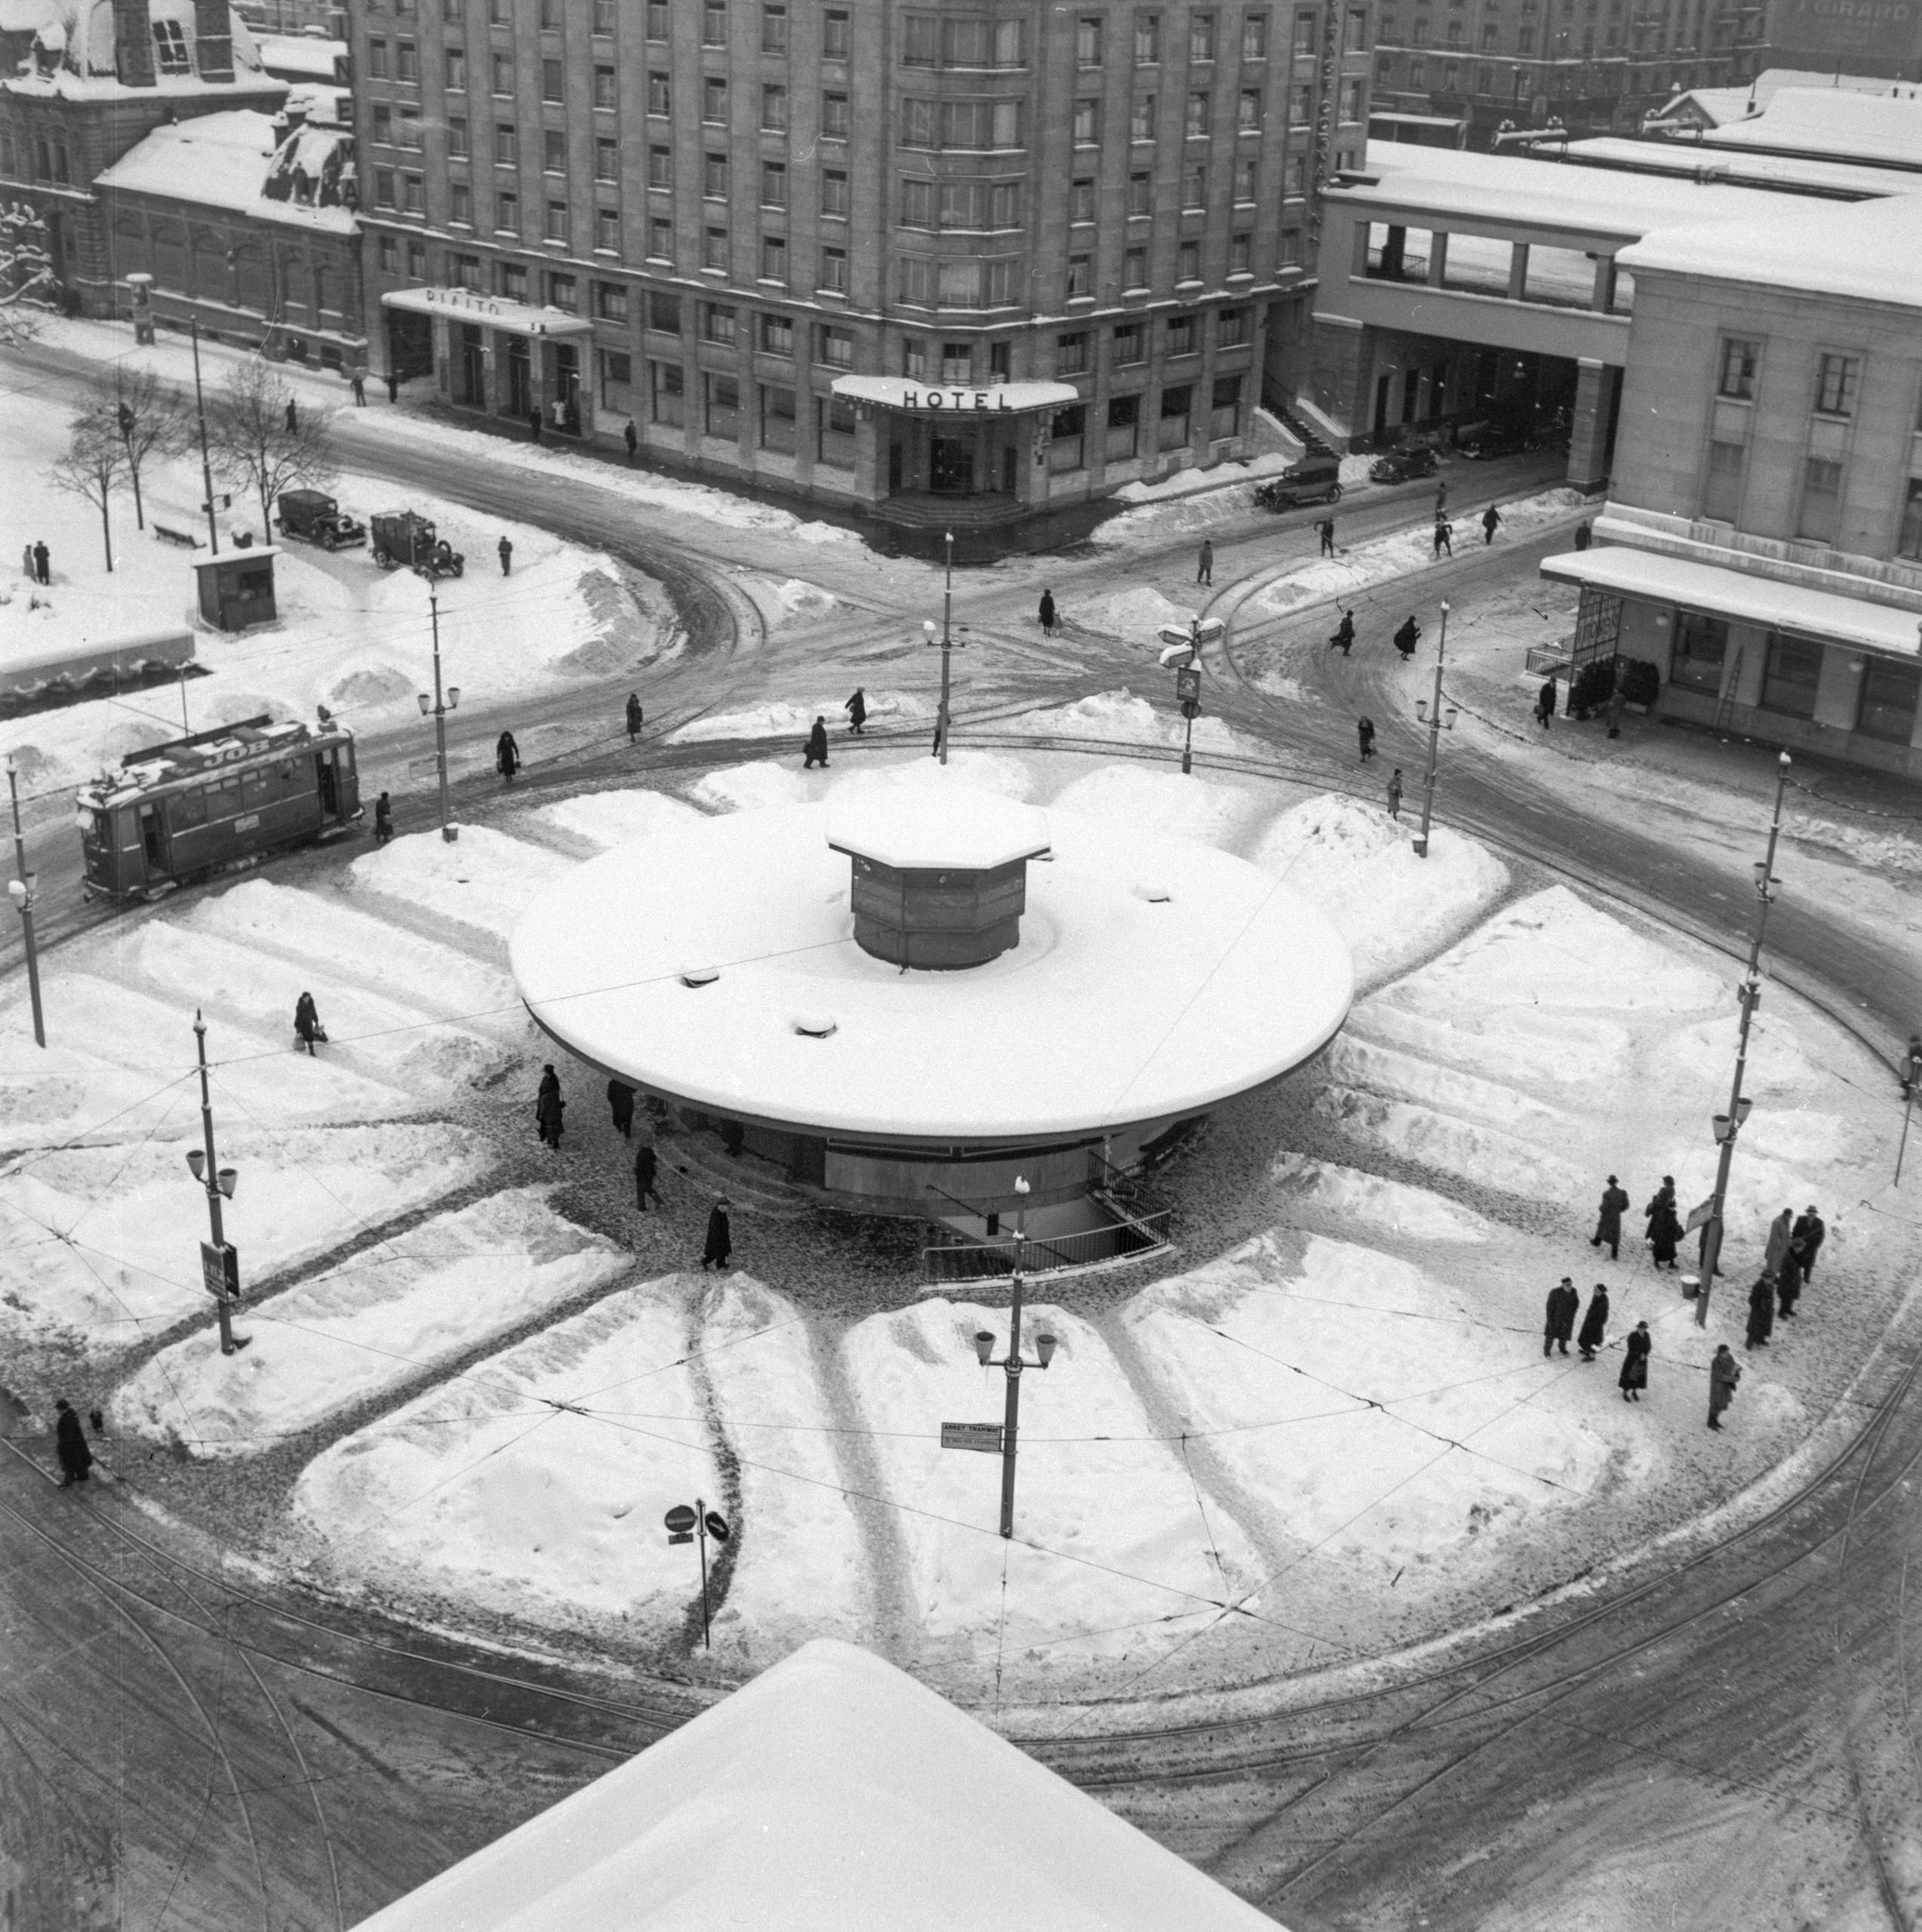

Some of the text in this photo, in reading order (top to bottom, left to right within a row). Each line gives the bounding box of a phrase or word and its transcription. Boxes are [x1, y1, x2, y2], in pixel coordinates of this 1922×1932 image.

[1814, 0, 1911, 21] GIRARD
[904, 390, 1013, 411] HOTEL
[203, 739, 270, 768] JOB
